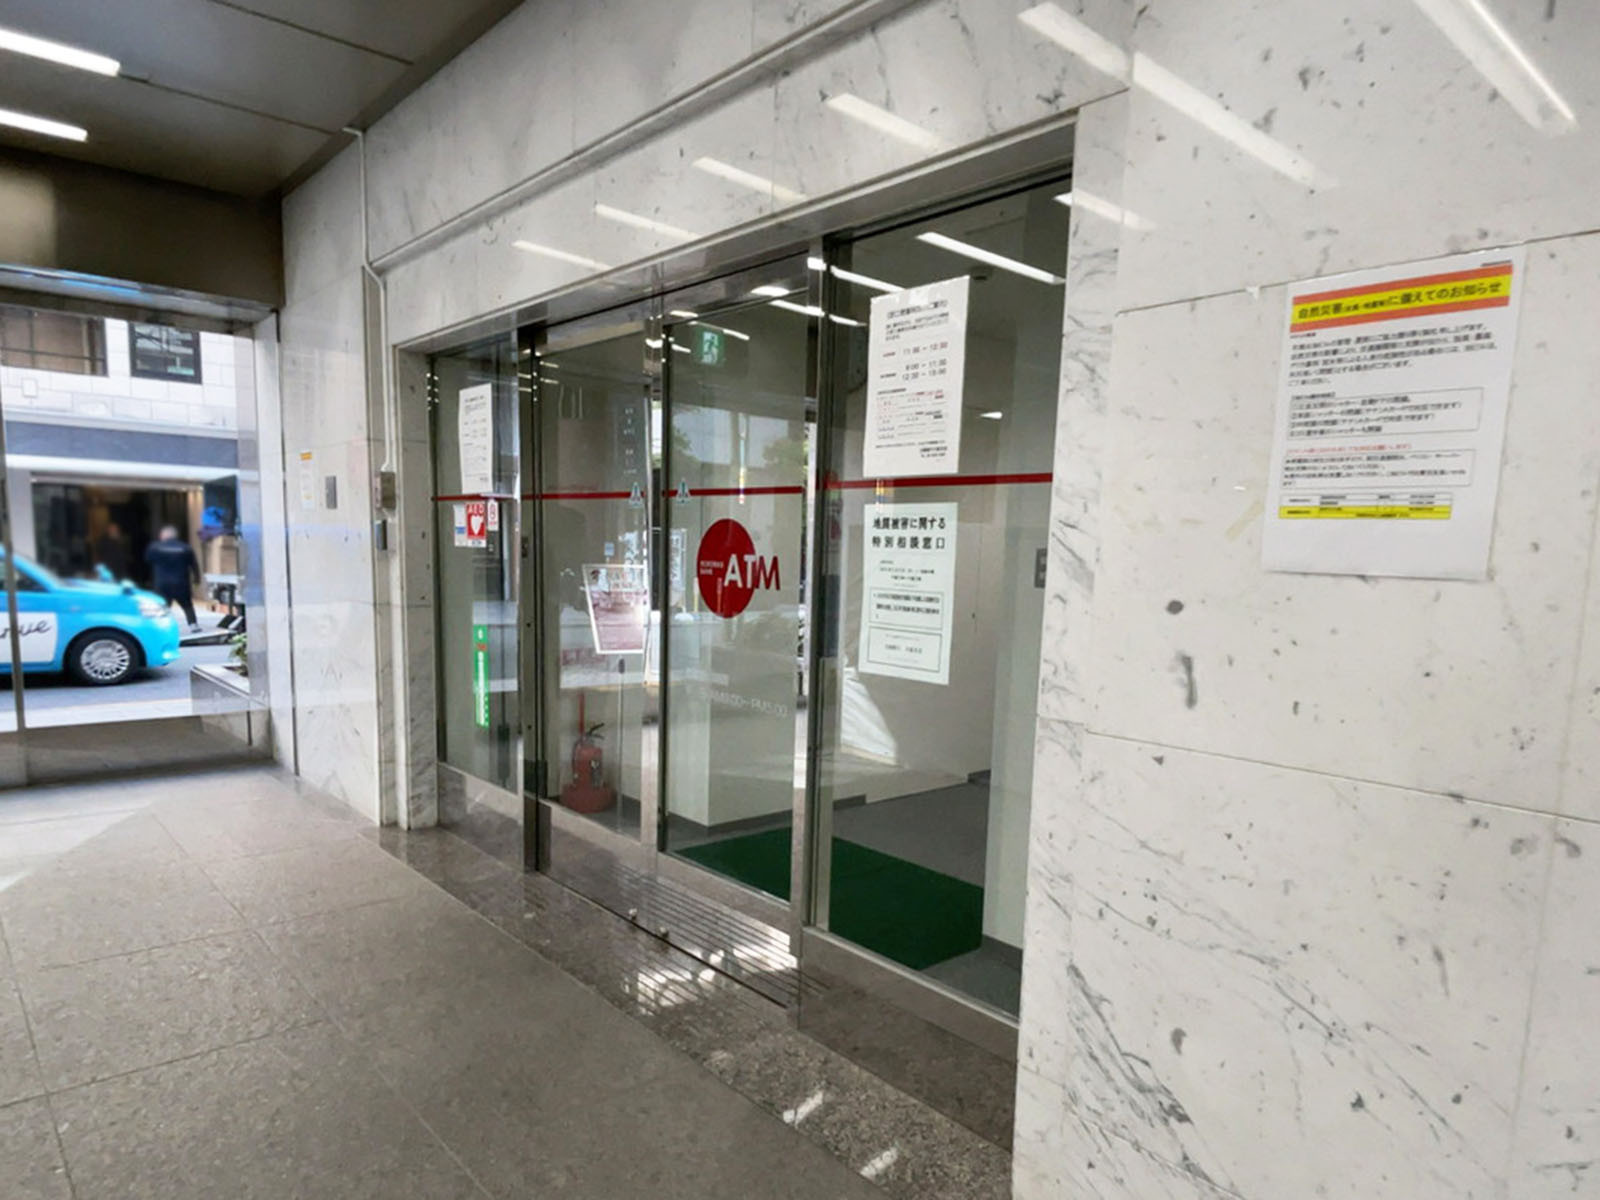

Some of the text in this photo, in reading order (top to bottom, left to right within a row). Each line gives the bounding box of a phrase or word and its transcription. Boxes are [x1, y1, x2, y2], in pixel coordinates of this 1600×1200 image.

[467, 503, 485, 513] AED
[873, 517, 946, 530] 地震被害に関する
[872, 536, 945, 549] 特別相談窓口
[723, 553, 781, 591] ATM
